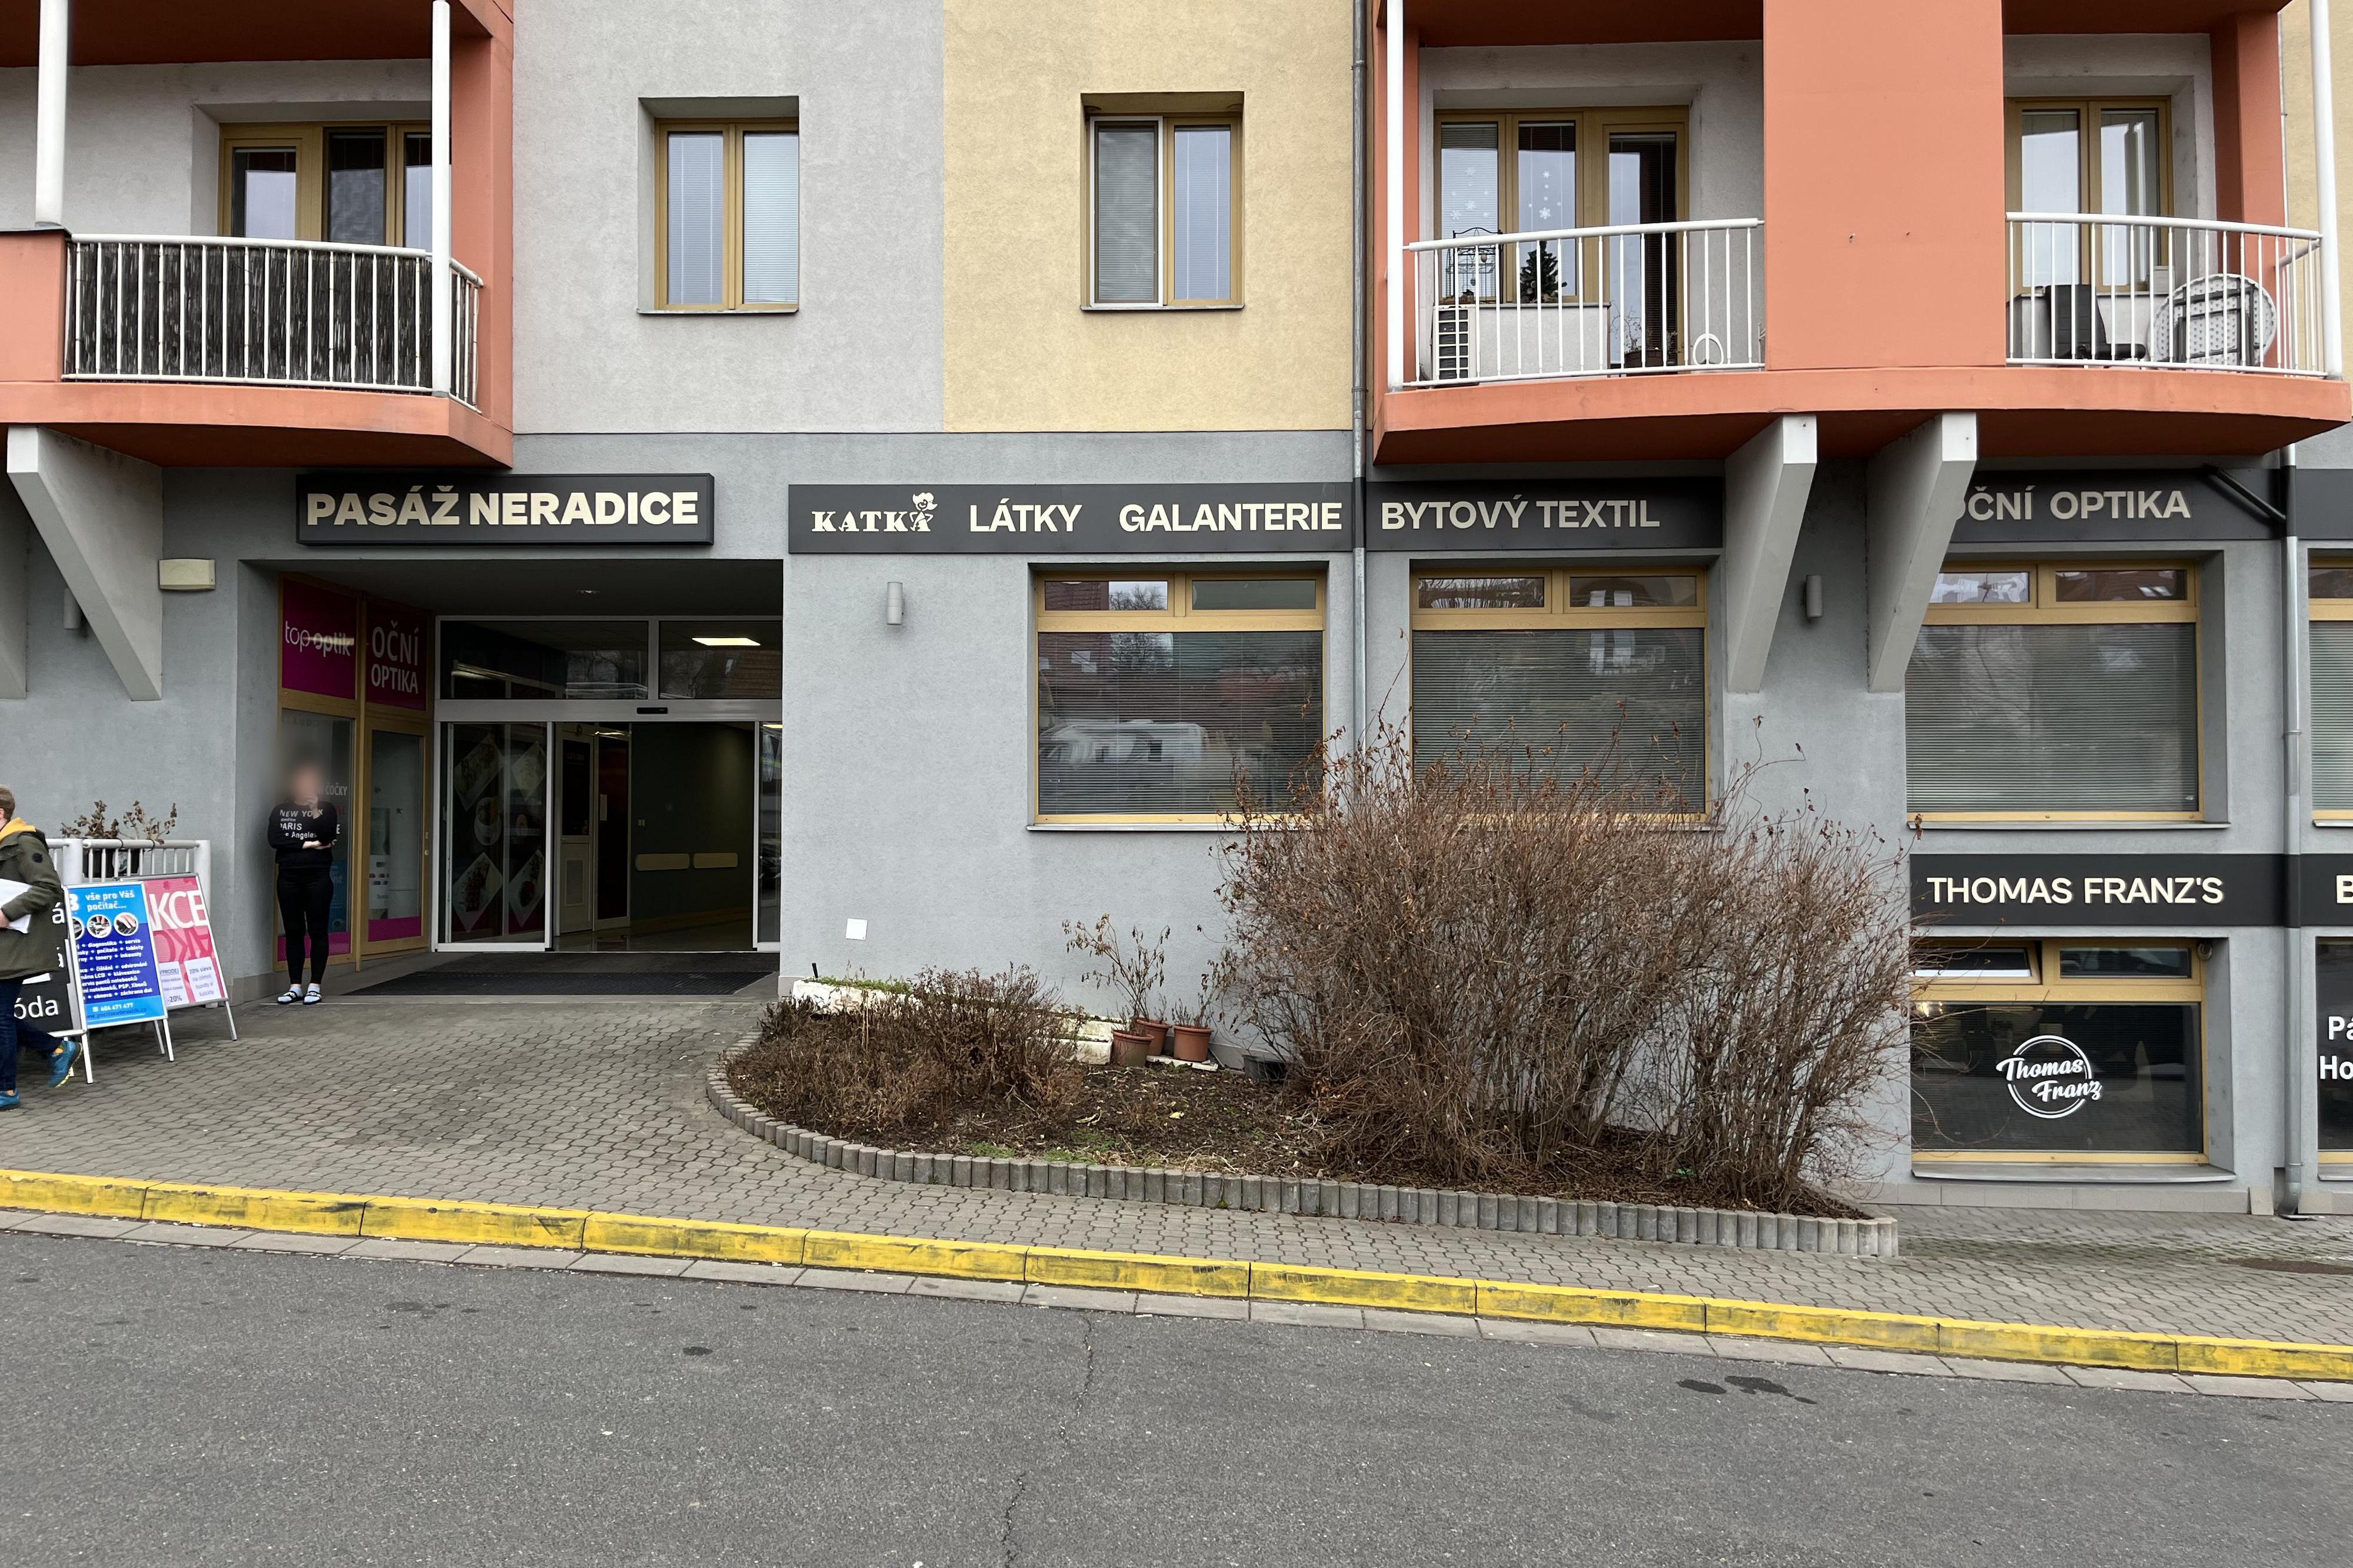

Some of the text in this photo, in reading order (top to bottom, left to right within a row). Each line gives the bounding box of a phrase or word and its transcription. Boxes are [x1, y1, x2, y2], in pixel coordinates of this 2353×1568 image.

[307, 485, 698, 526] PASÁŽ NERADICE
[970, 498, 1082, 532] LÁTKY
[1119, 502, 1343, 532] GALANTERIE
[1382, 494, 1660, 530] BYTOVÝ TEXTIL
[1957, 485, 2191, 521] ČNÍ OPTIKA
[285, 620, 351, 658] top optik
[372, 619, 419, 666] OČNÍ
[371, 663, 419, 695] OPTIKA
[279, 809, 299, 818] NEW
[301, 809, 324, 818] YOK
[85, 892, 101, 900] vše
[118, 889, 135, 899] Váš
[1926, 877, 2224, 904] THOMAS FRANZ'S
[1995, 1057, 2084, 1081] Thomas
[2031, 1080, 2103, 1102] Franz
